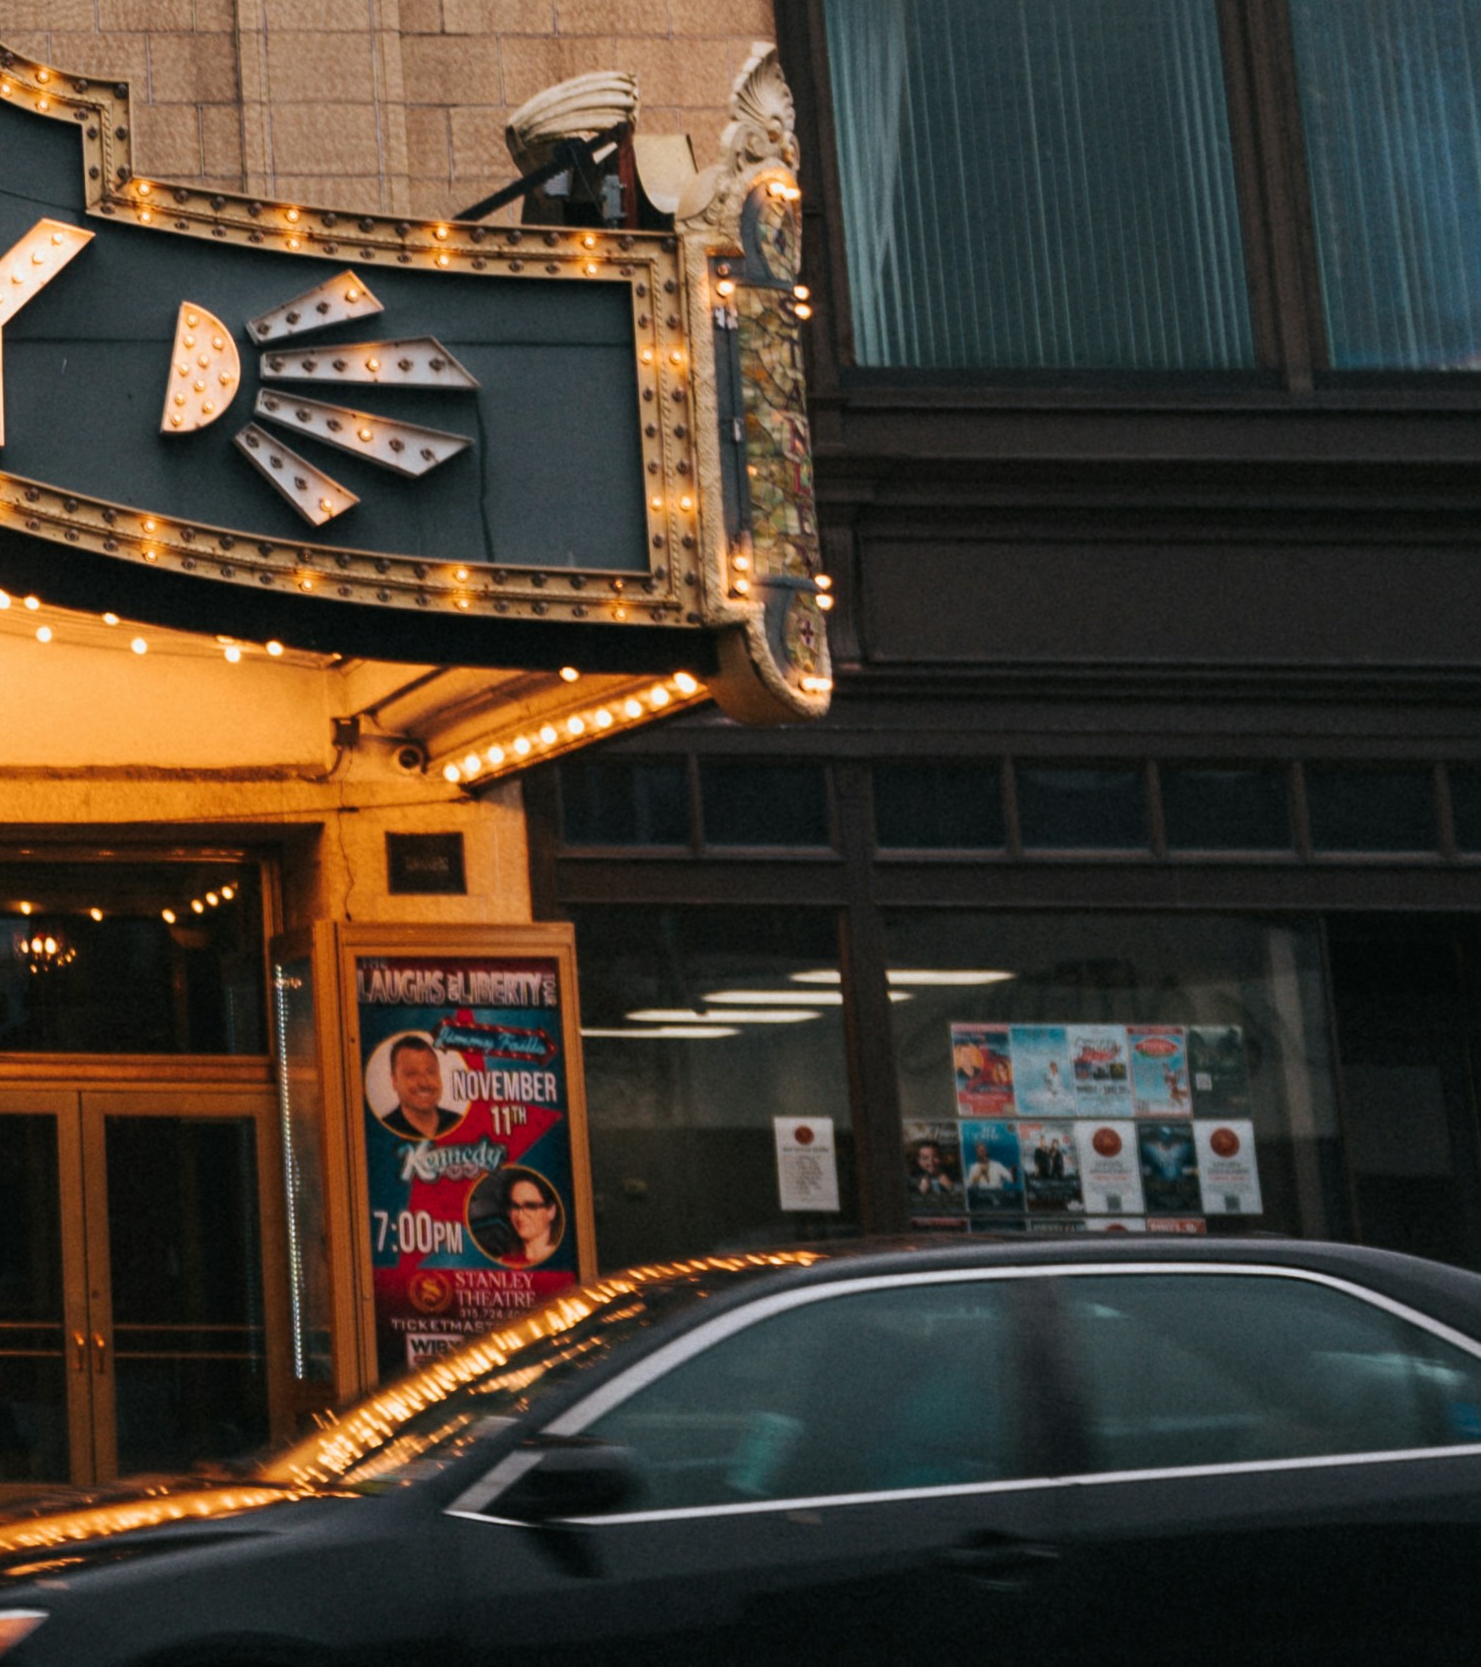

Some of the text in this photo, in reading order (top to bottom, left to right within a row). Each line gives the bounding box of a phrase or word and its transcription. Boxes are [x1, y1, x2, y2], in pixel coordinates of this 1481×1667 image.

[357, 969, 446, 1005] LAUGHS
[457, 970, 544, 1006] LIBERTY
[452, 1070, 558, 1103] NOVEMBER
[398, 1139, 506, 1182] Kennedy
[373, 1210, 463, 1254] 7:00PM
[454, 1270, 534, 1289] STANLEY
[455, 1289, 536, 1308] THEATRE
